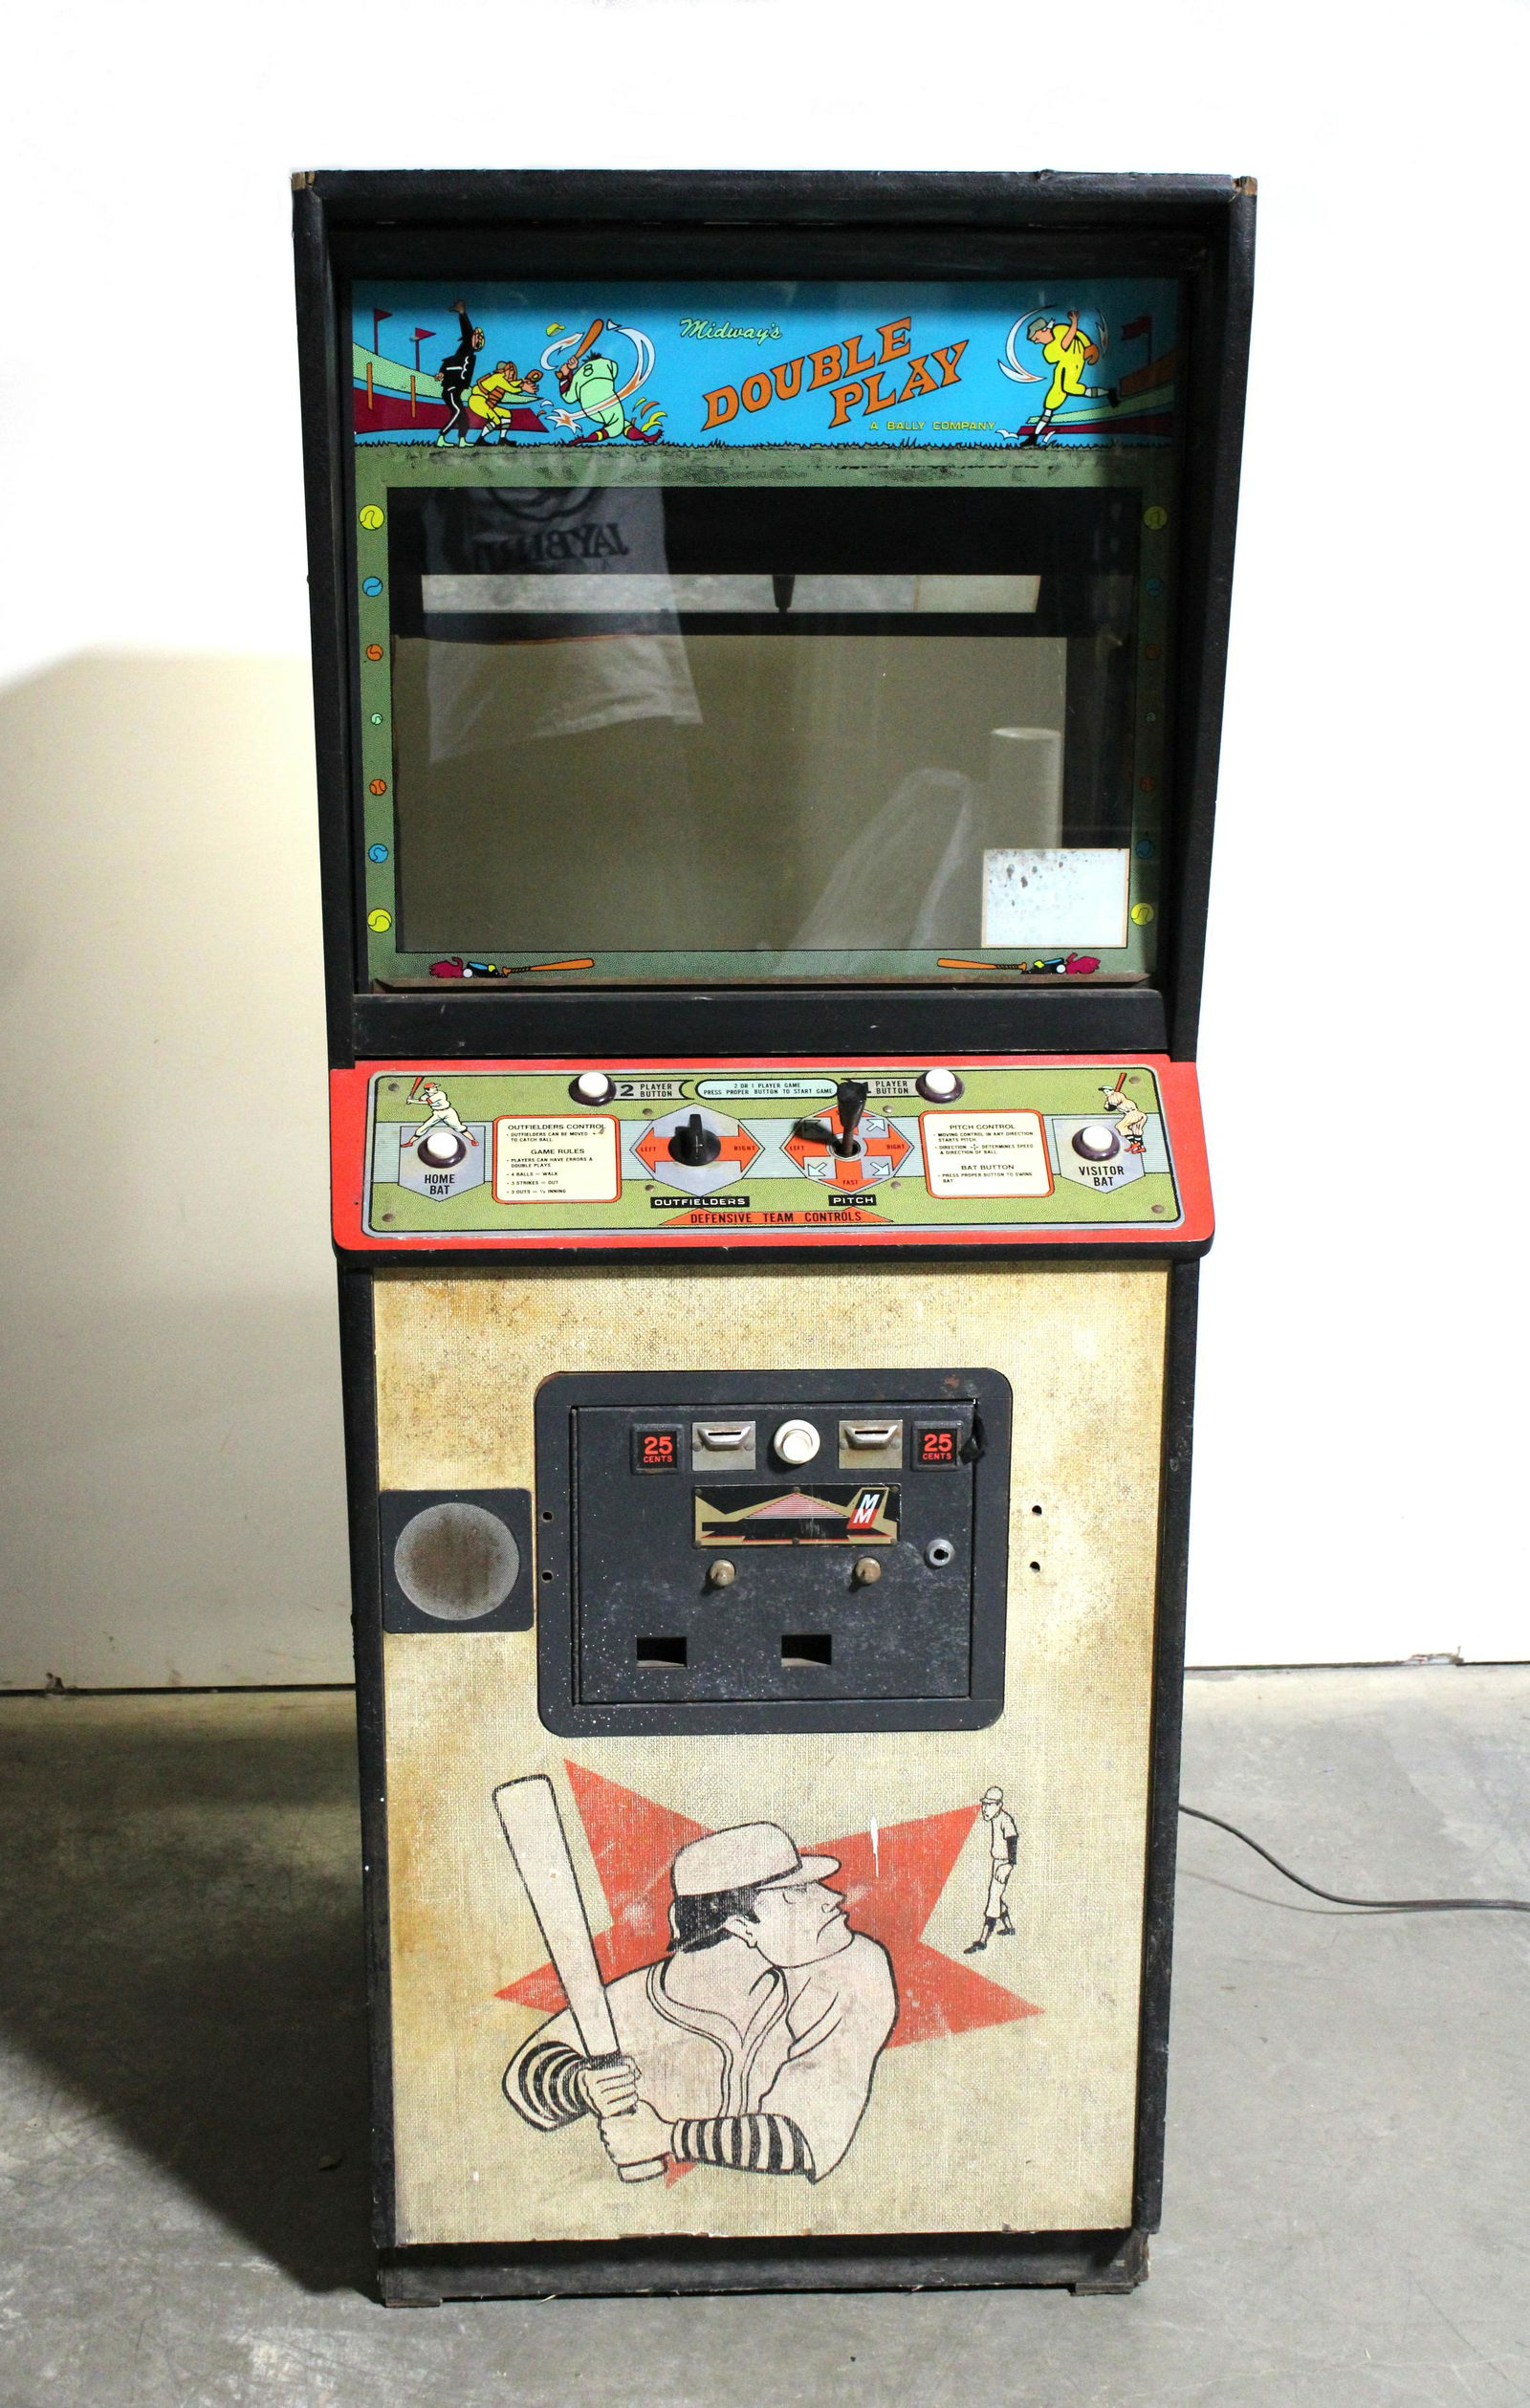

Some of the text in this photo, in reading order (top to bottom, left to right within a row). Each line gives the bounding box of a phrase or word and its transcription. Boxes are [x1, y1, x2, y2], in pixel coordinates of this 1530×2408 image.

[679, 318, 782, 345] Midway's
[583, 364, 594, 377] 8
[701, 317, 911, 431] DOUBLE
[828, 339, 970, 429] PLAY
[870, 421, 996, 430] A BALLY COMPANY
[620, 1085, 634, 1097] 2
[1078, 1165, 1125, 1176] VISITOR
[424, 1173, 456, 1185] HOME
[1093, 1176, 1115, 1187] BAT
[429, 1184, 450, 1195] BAT
[654, 1197, 746, 1206] OUTFIELDERS
[690, 1212, 862, 1224] DEFENSIVE TEAM CONTROLS
[644, 1436, 673, 1455] 25
[924, 1433, 952, 1453] 25
[643, 1455, 672, 1463] CENTS
